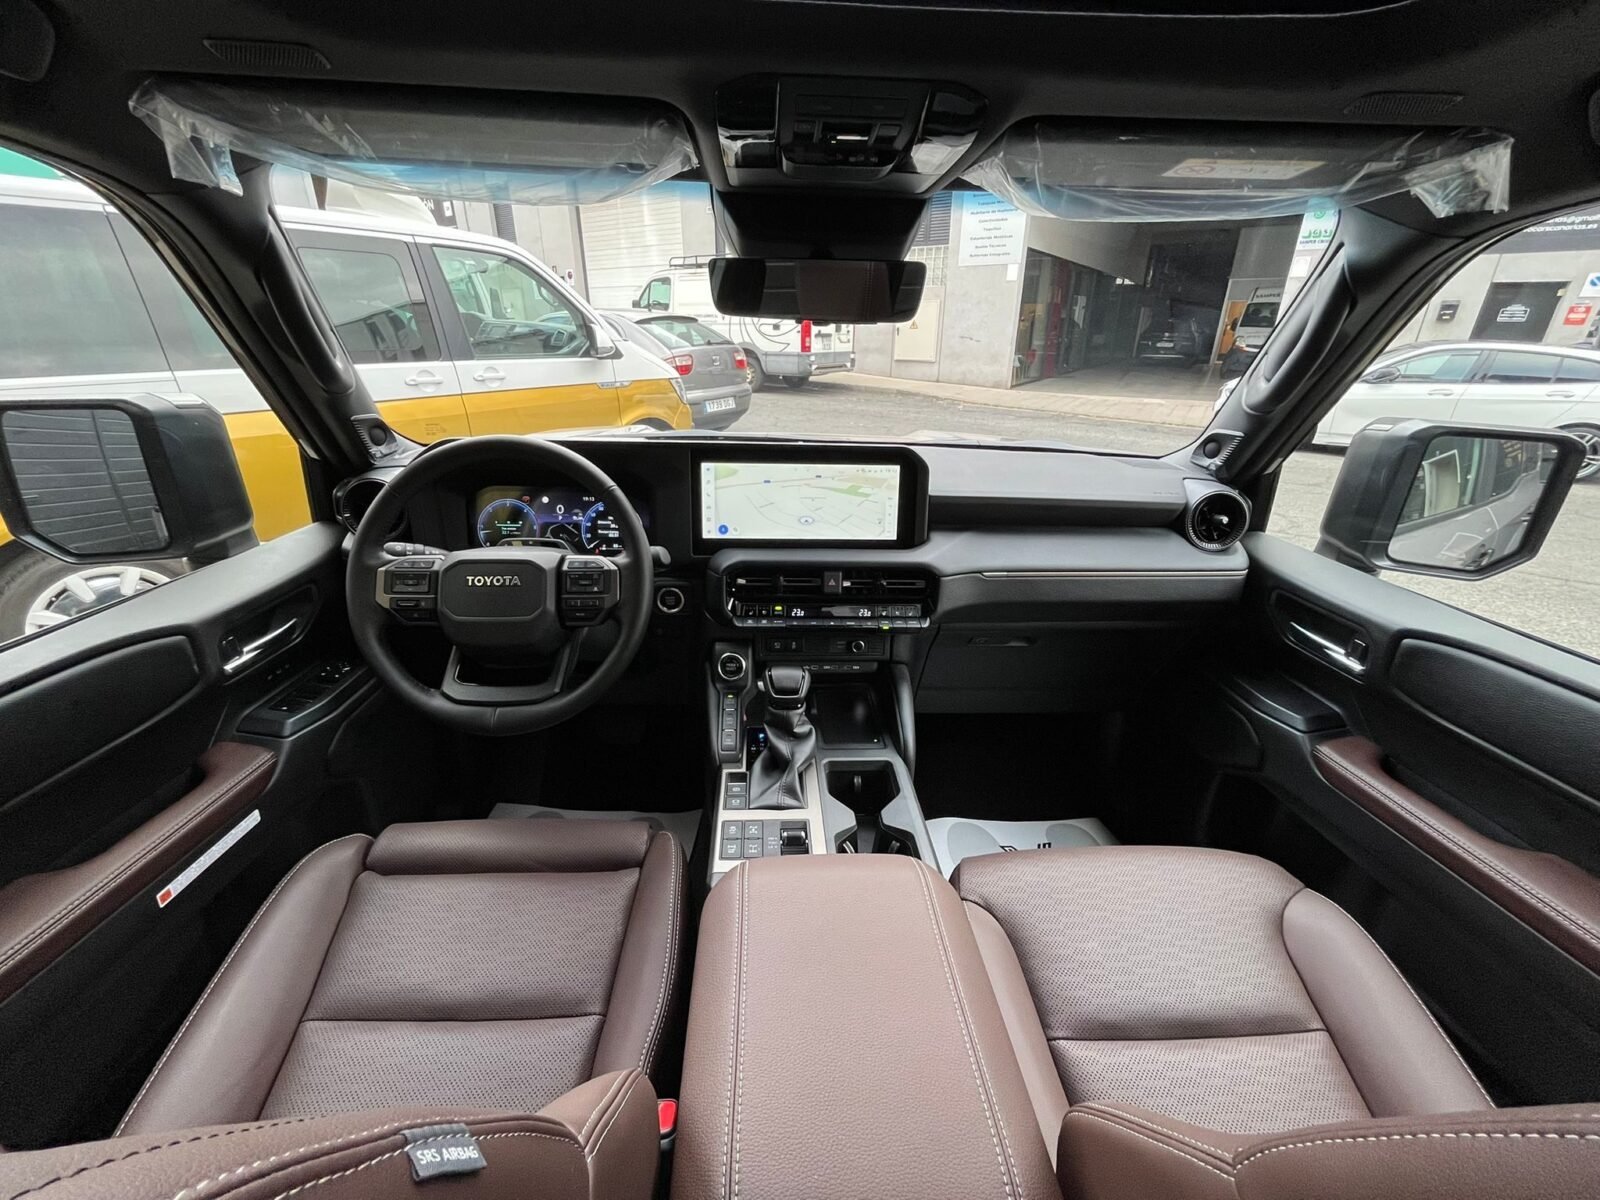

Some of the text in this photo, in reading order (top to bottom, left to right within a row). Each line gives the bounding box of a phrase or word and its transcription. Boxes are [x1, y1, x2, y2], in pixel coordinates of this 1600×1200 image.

[466, 575, 521, 586] TOYOTA
[416, 1145, 479, 1165] SRS AIRBAG
